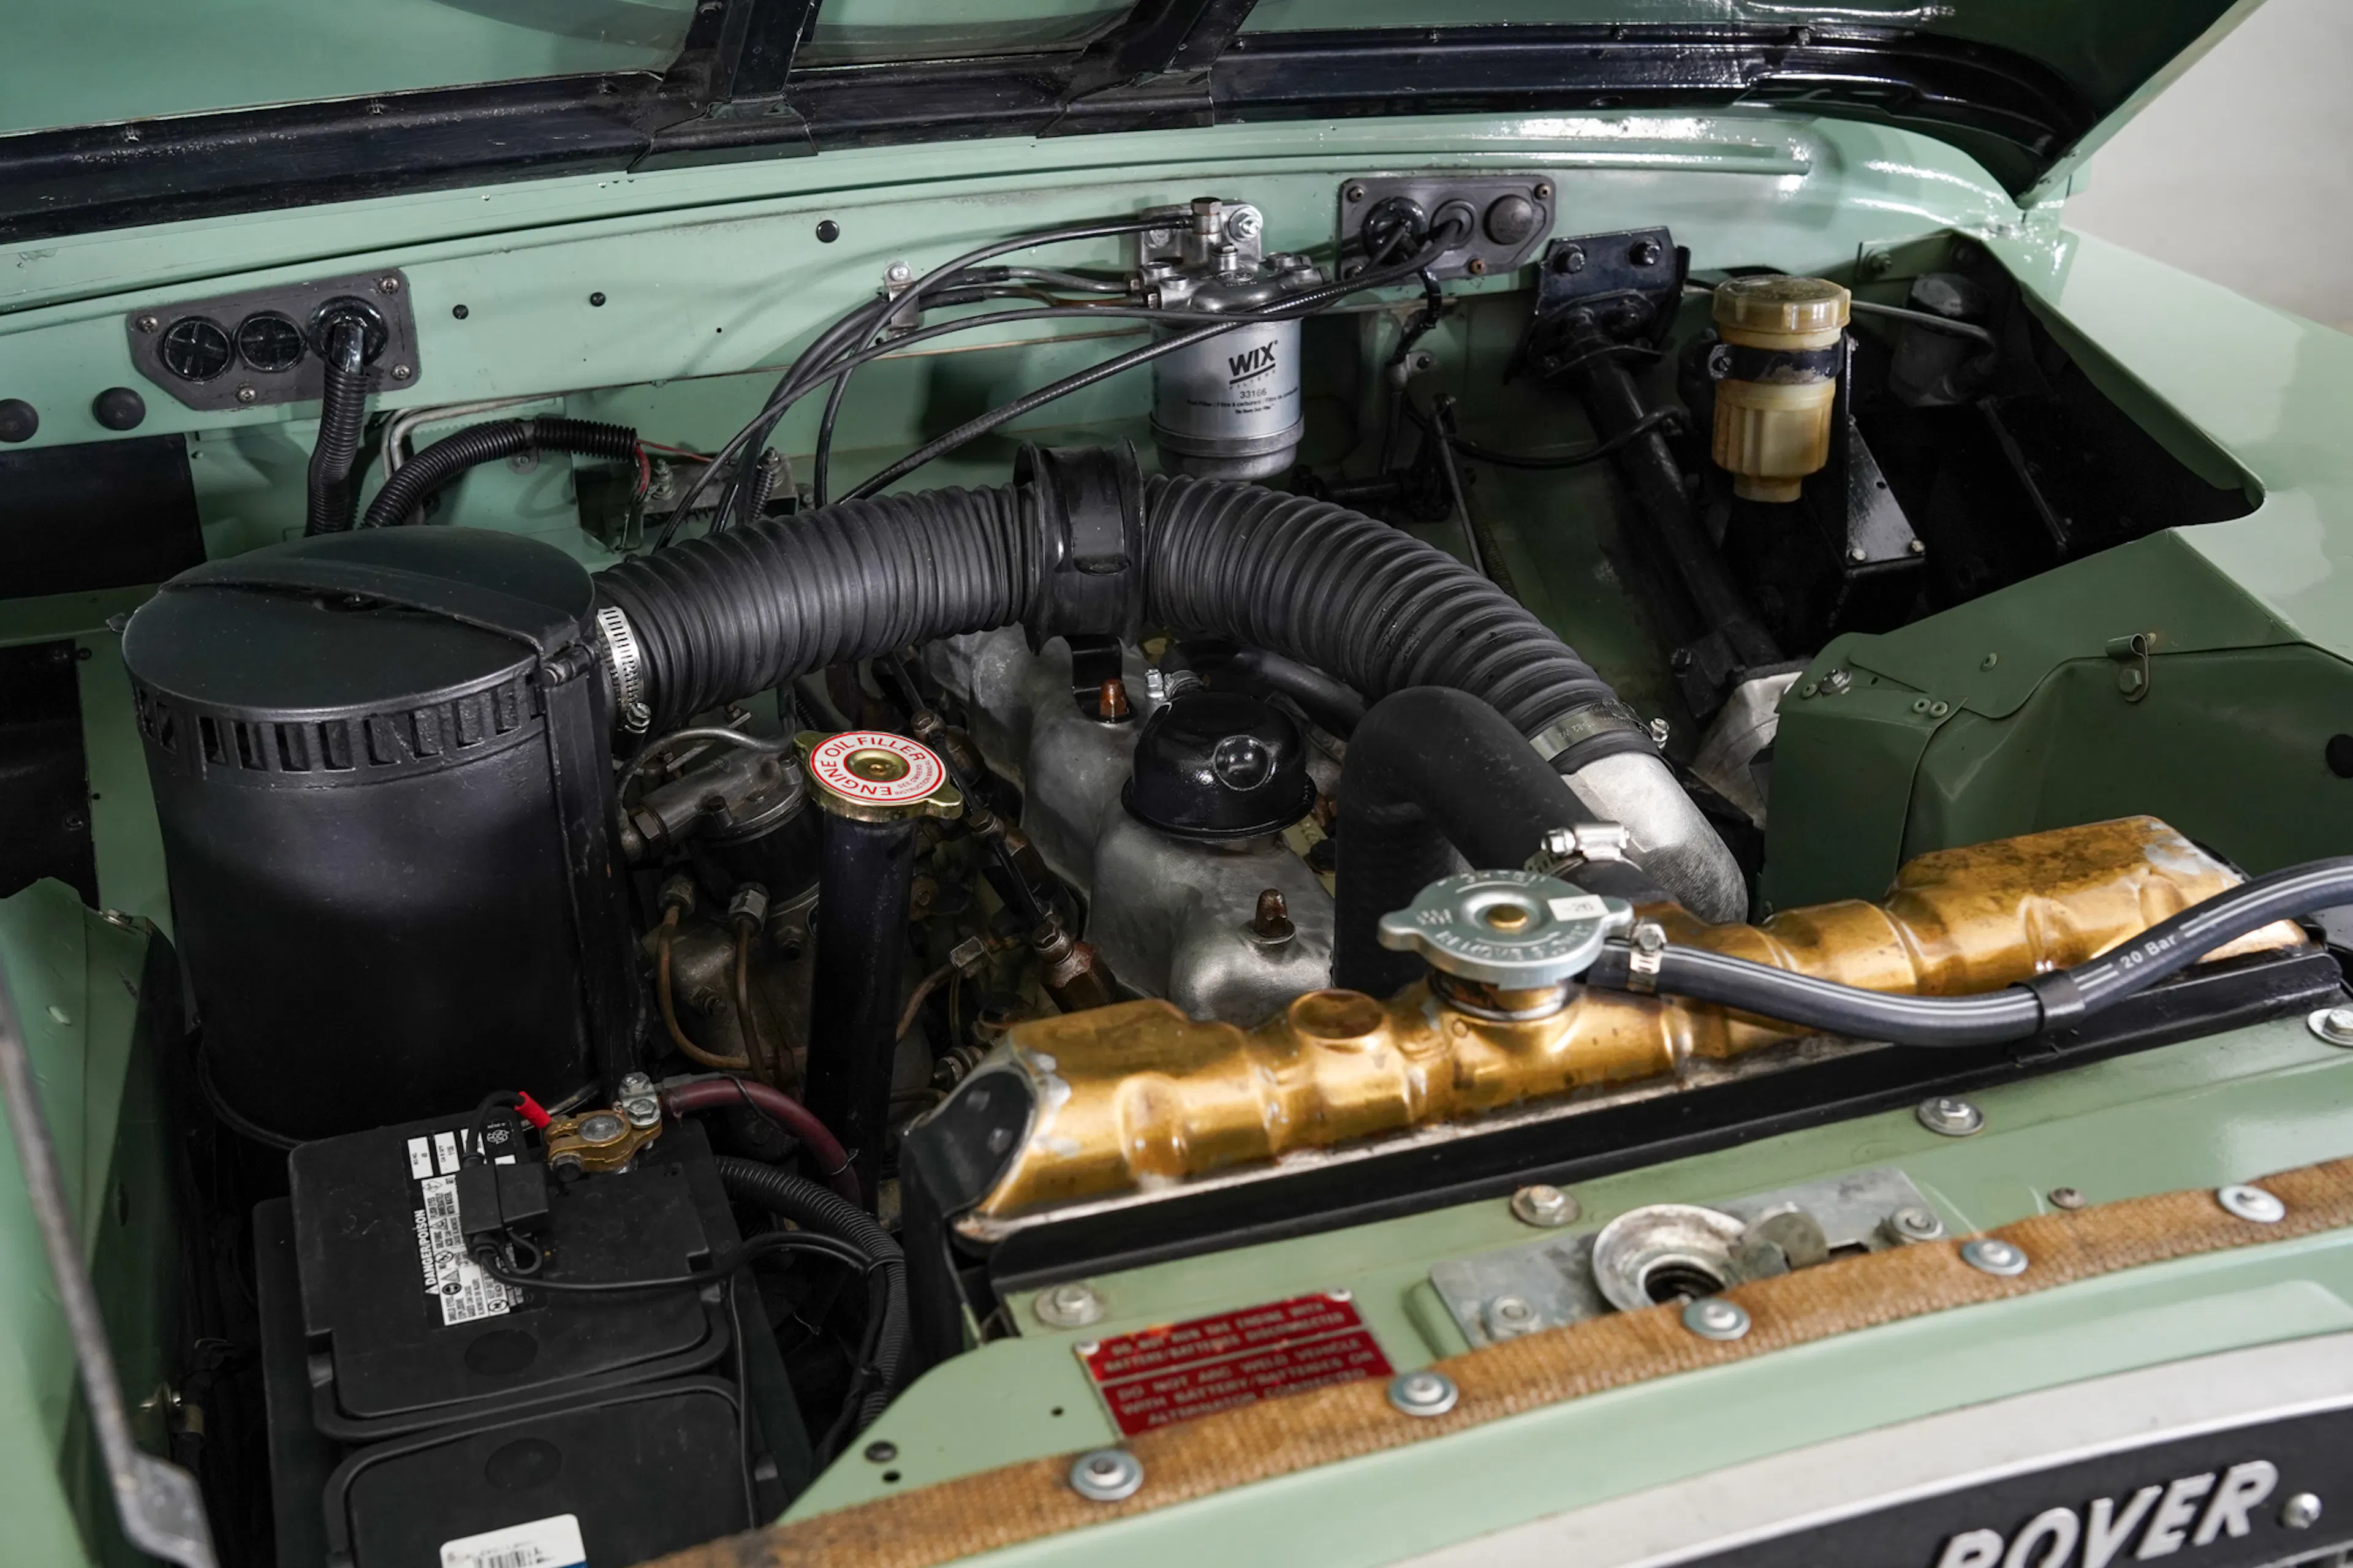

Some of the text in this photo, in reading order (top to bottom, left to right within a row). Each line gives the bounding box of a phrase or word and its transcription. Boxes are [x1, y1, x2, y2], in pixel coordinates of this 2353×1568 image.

[1229, 341, 1276, 376] WIX
[821, 737, 926, 795] ENGINE OIL FILLER
[2120, 934, 2177, 971] 20 Bar
[414, 1209, 438, 1286] DANGER/POISON
